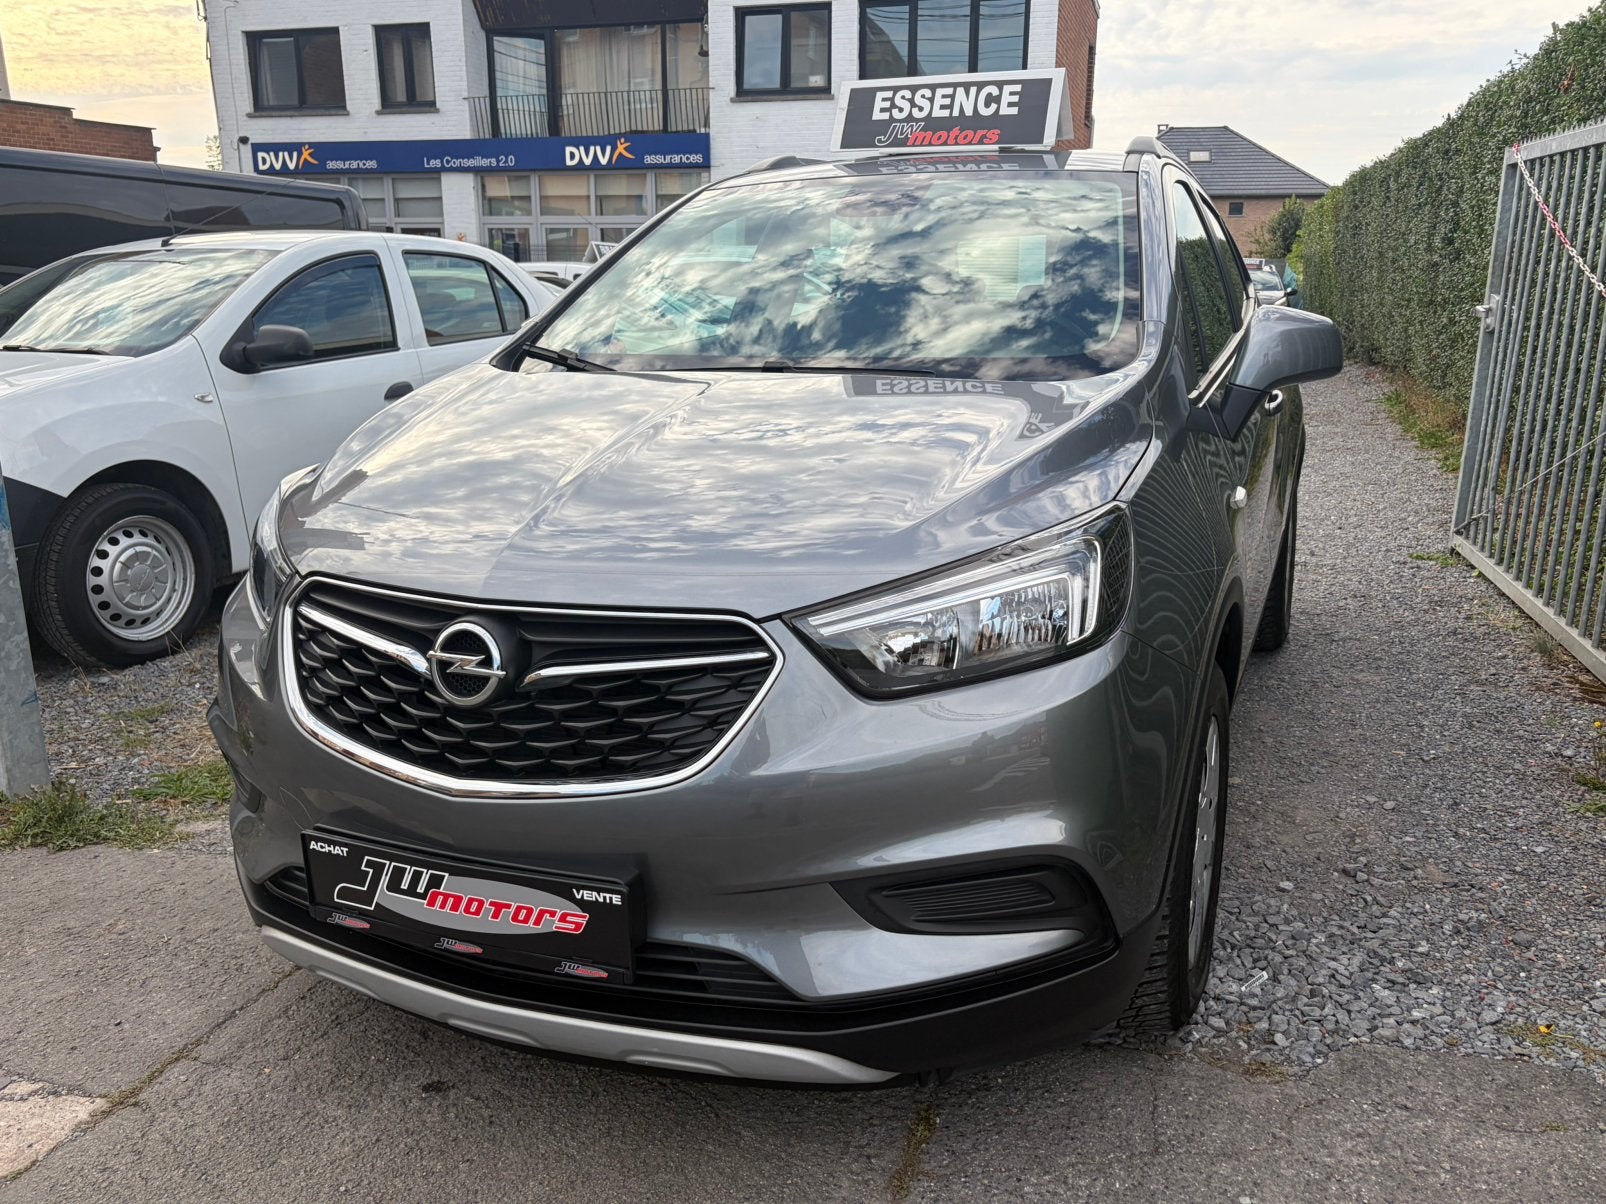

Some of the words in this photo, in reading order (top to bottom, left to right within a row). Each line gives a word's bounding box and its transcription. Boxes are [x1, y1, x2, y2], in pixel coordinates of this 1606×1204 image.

[871, 84, 1022, 121] ESSENCE
[906, 126, 1000, 146] motors
[257, 151, 298, 171] DVV
[326, 159, 378, 170] assurances
[423, 157, 441, 168] Les
[443, 156, 497, 168] Conseillers
[498, 155, 515, 167] 2.0
[565, 145, 612, 166] DVV
[643, 153, 703, 164] assurances
[309, 840, 349, 857] ACHAT
[572, 888, 623, 906] VENTE
